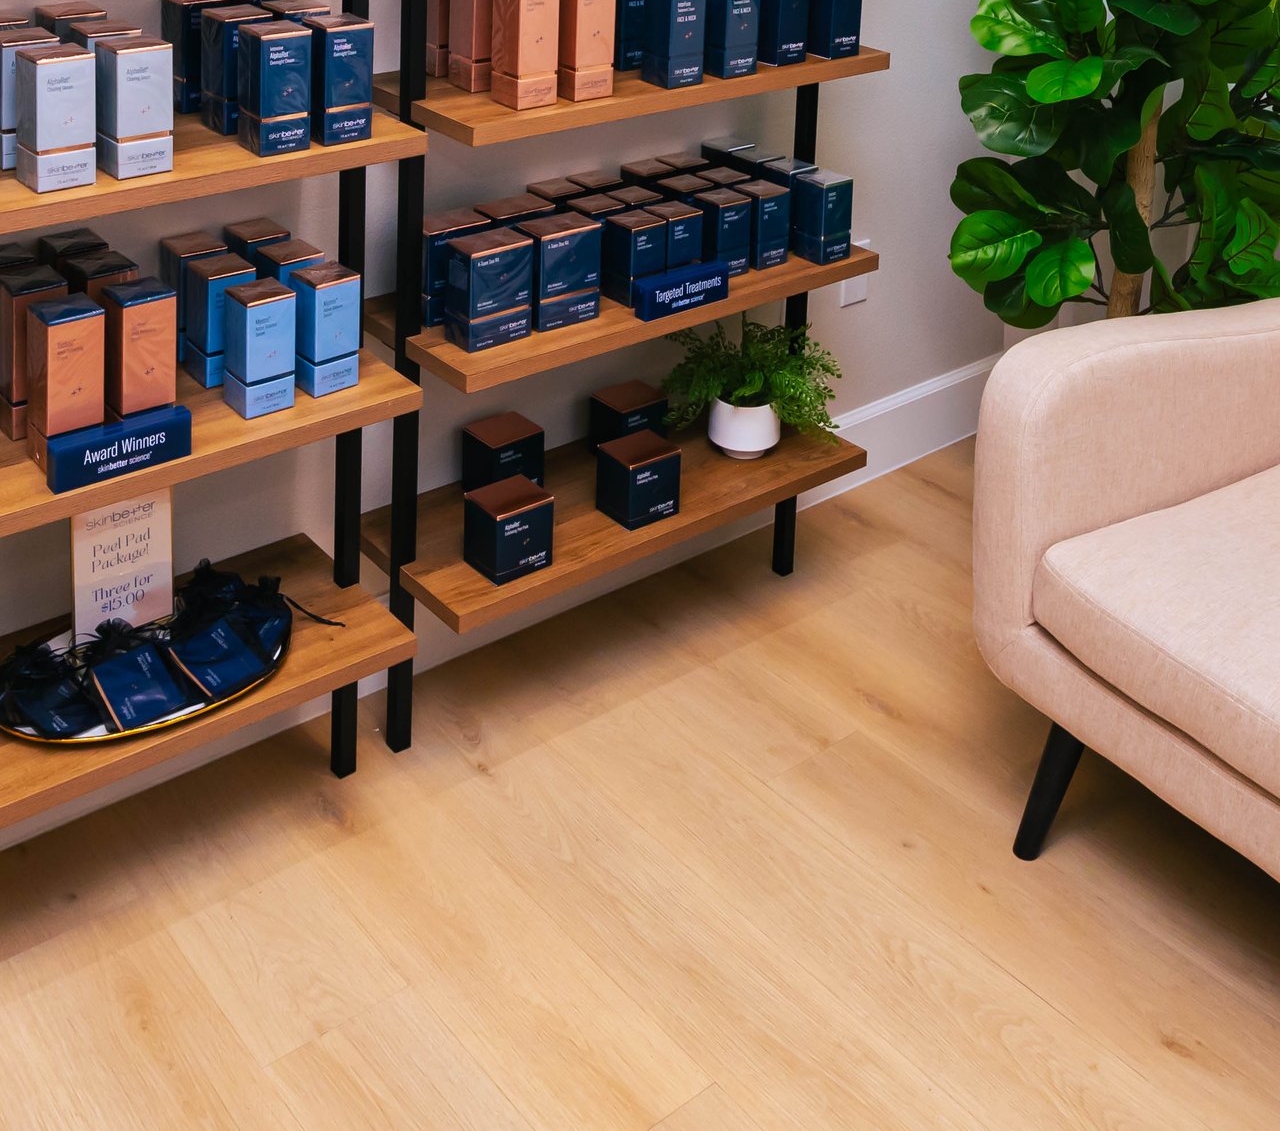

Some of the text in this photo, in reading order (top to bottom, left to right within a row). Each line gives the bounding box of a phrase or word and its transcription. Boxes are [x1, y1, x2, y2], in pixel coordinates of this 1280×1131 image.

[270, 51, 289, 59] AlphaRet
[47, 76, 69, 86] AlphaRet
[127, 67, 147, 75] AlphaRet
[48, 163, 88, 175] skinbetter
[656, 275, 722, 304] Targeted Treatments
[84, 432, 166, 466] Award Winners
[98, 454, 151, 474] skinbetter science
[86, 501, 156, 531] skinbetter
[113, 512, 153, 528] SCIENCE
[93, 527, 151, 558] Peel Pad
[92, 543, 149, 573] Package!
[92, 574, 154, 603] Three for
[101, 588, 145, 613] $15.00
